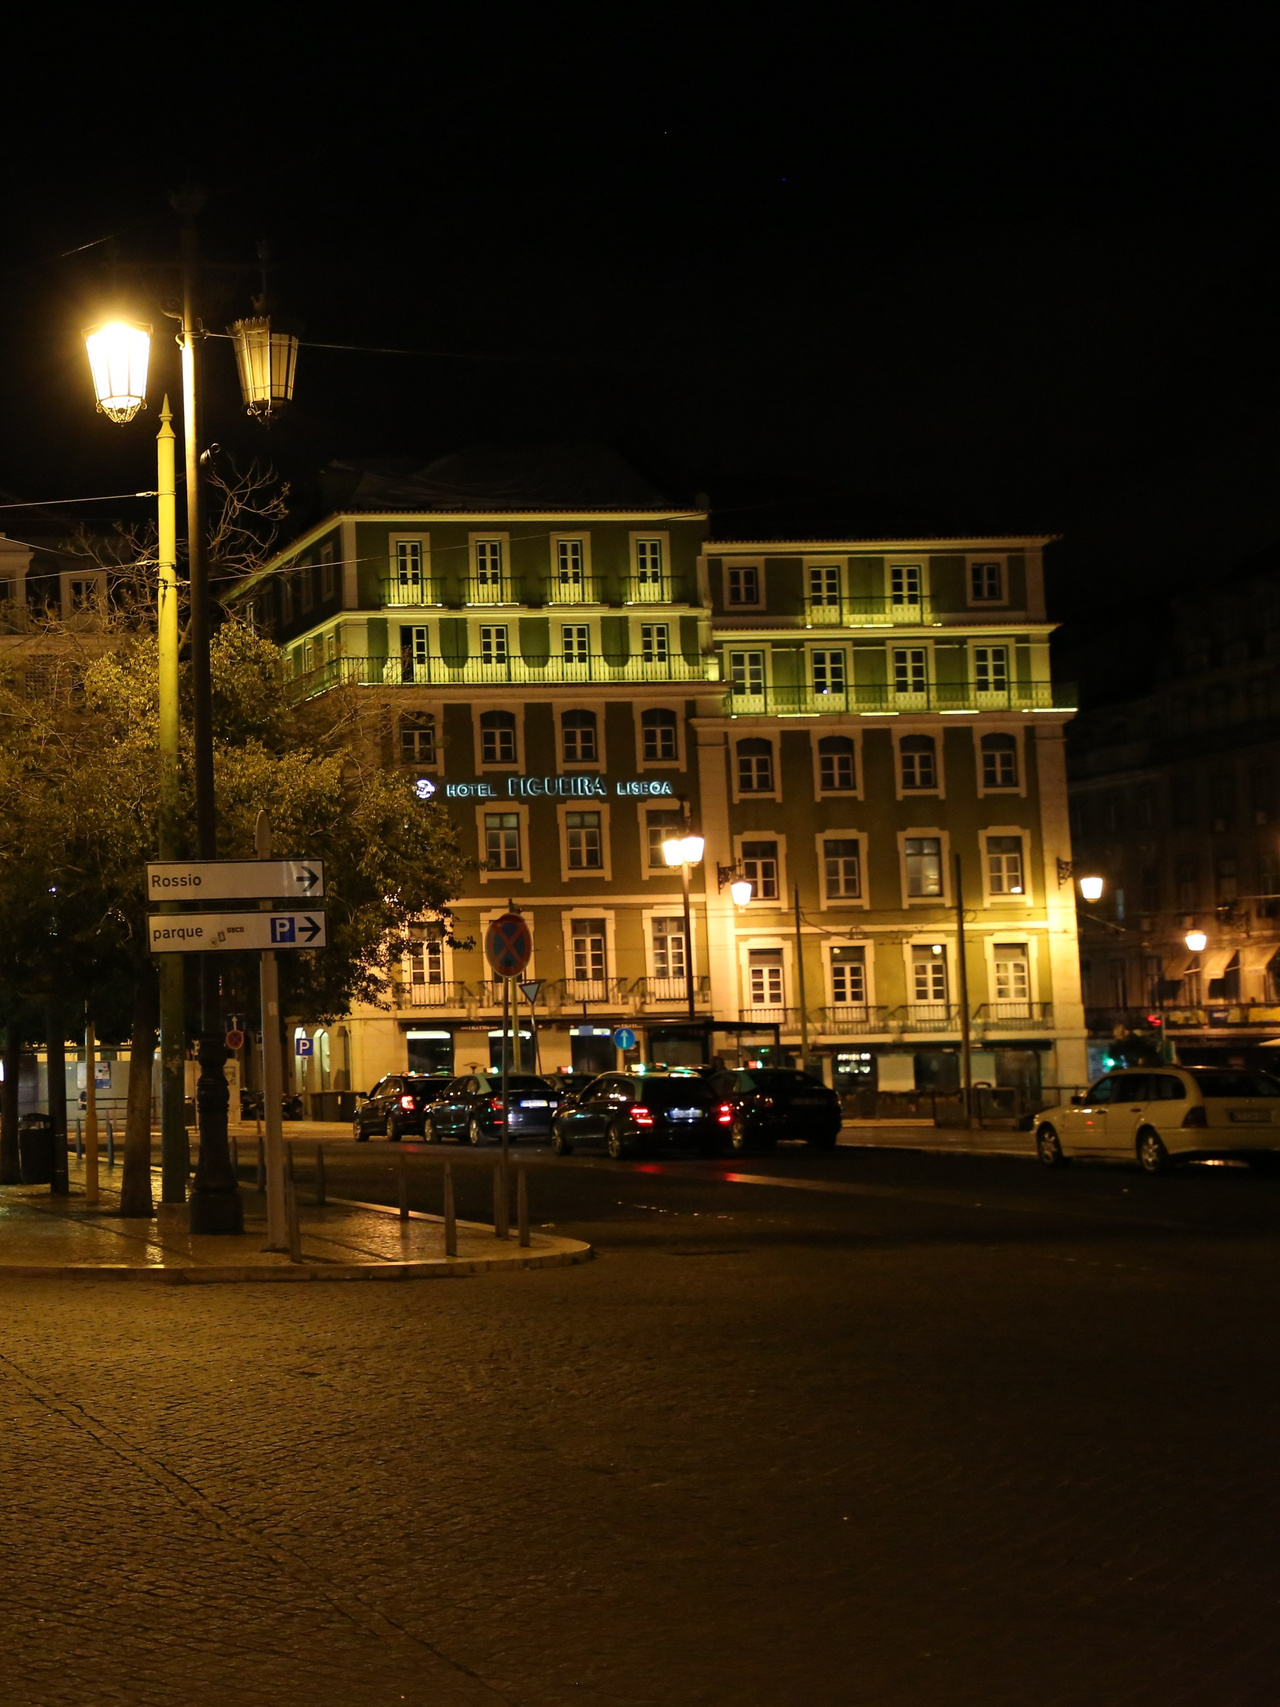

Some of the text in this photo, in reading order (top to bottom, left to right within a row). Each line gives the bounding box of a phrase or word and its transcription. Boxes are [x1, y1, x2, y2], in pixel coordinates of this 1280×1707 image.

[446, 776, 672, 797] HOTEL FIGUEIRA LISBOA
[151, 873, 202, 888] Rossio
[153, 919, 290, 942] parque P
[300, 1040, 310, 1054] P
